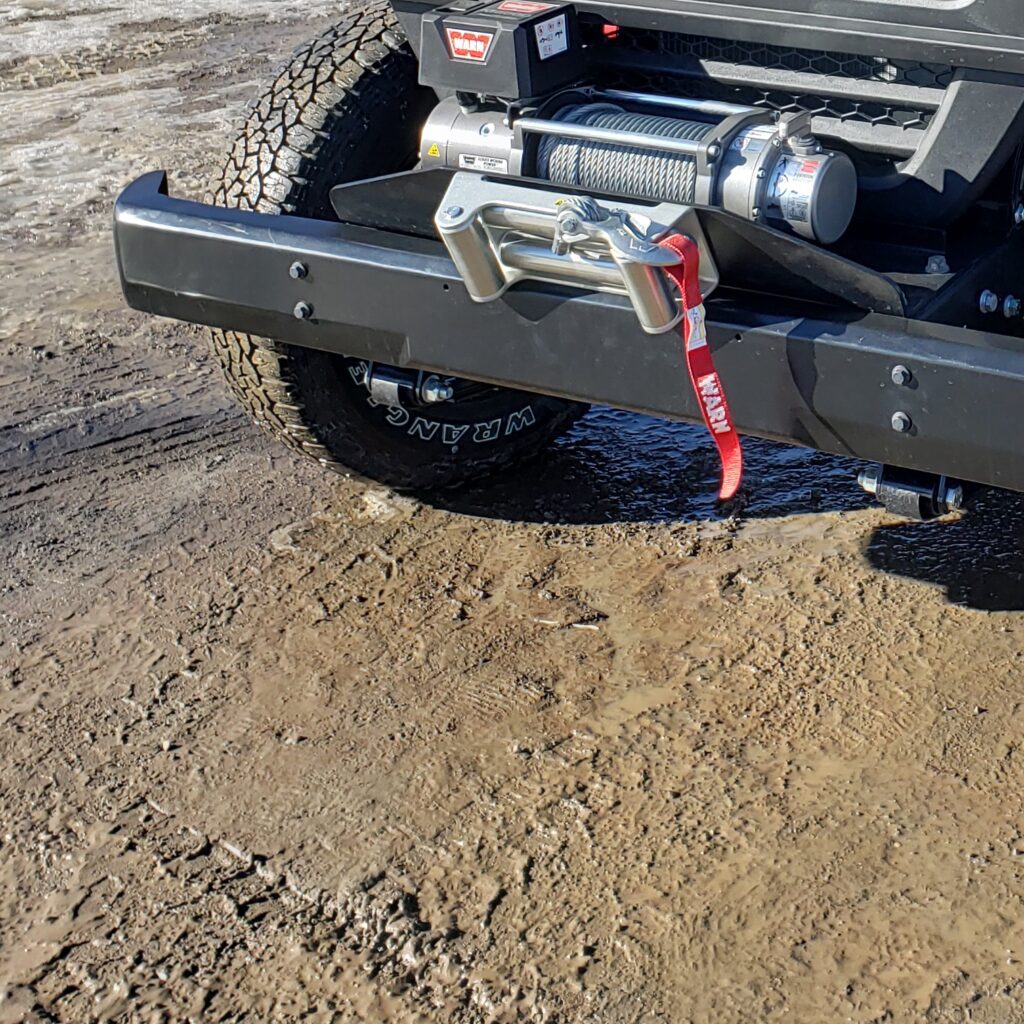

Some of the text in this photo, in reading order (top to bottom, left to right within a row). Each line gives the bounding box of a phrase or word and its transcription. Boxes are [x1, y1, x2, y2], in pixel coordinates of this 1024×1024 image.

[453, 37, 485, 52] WARN
[348, 361, 536, 445] WRANGE
[698, 374, 731, 434] WARN
